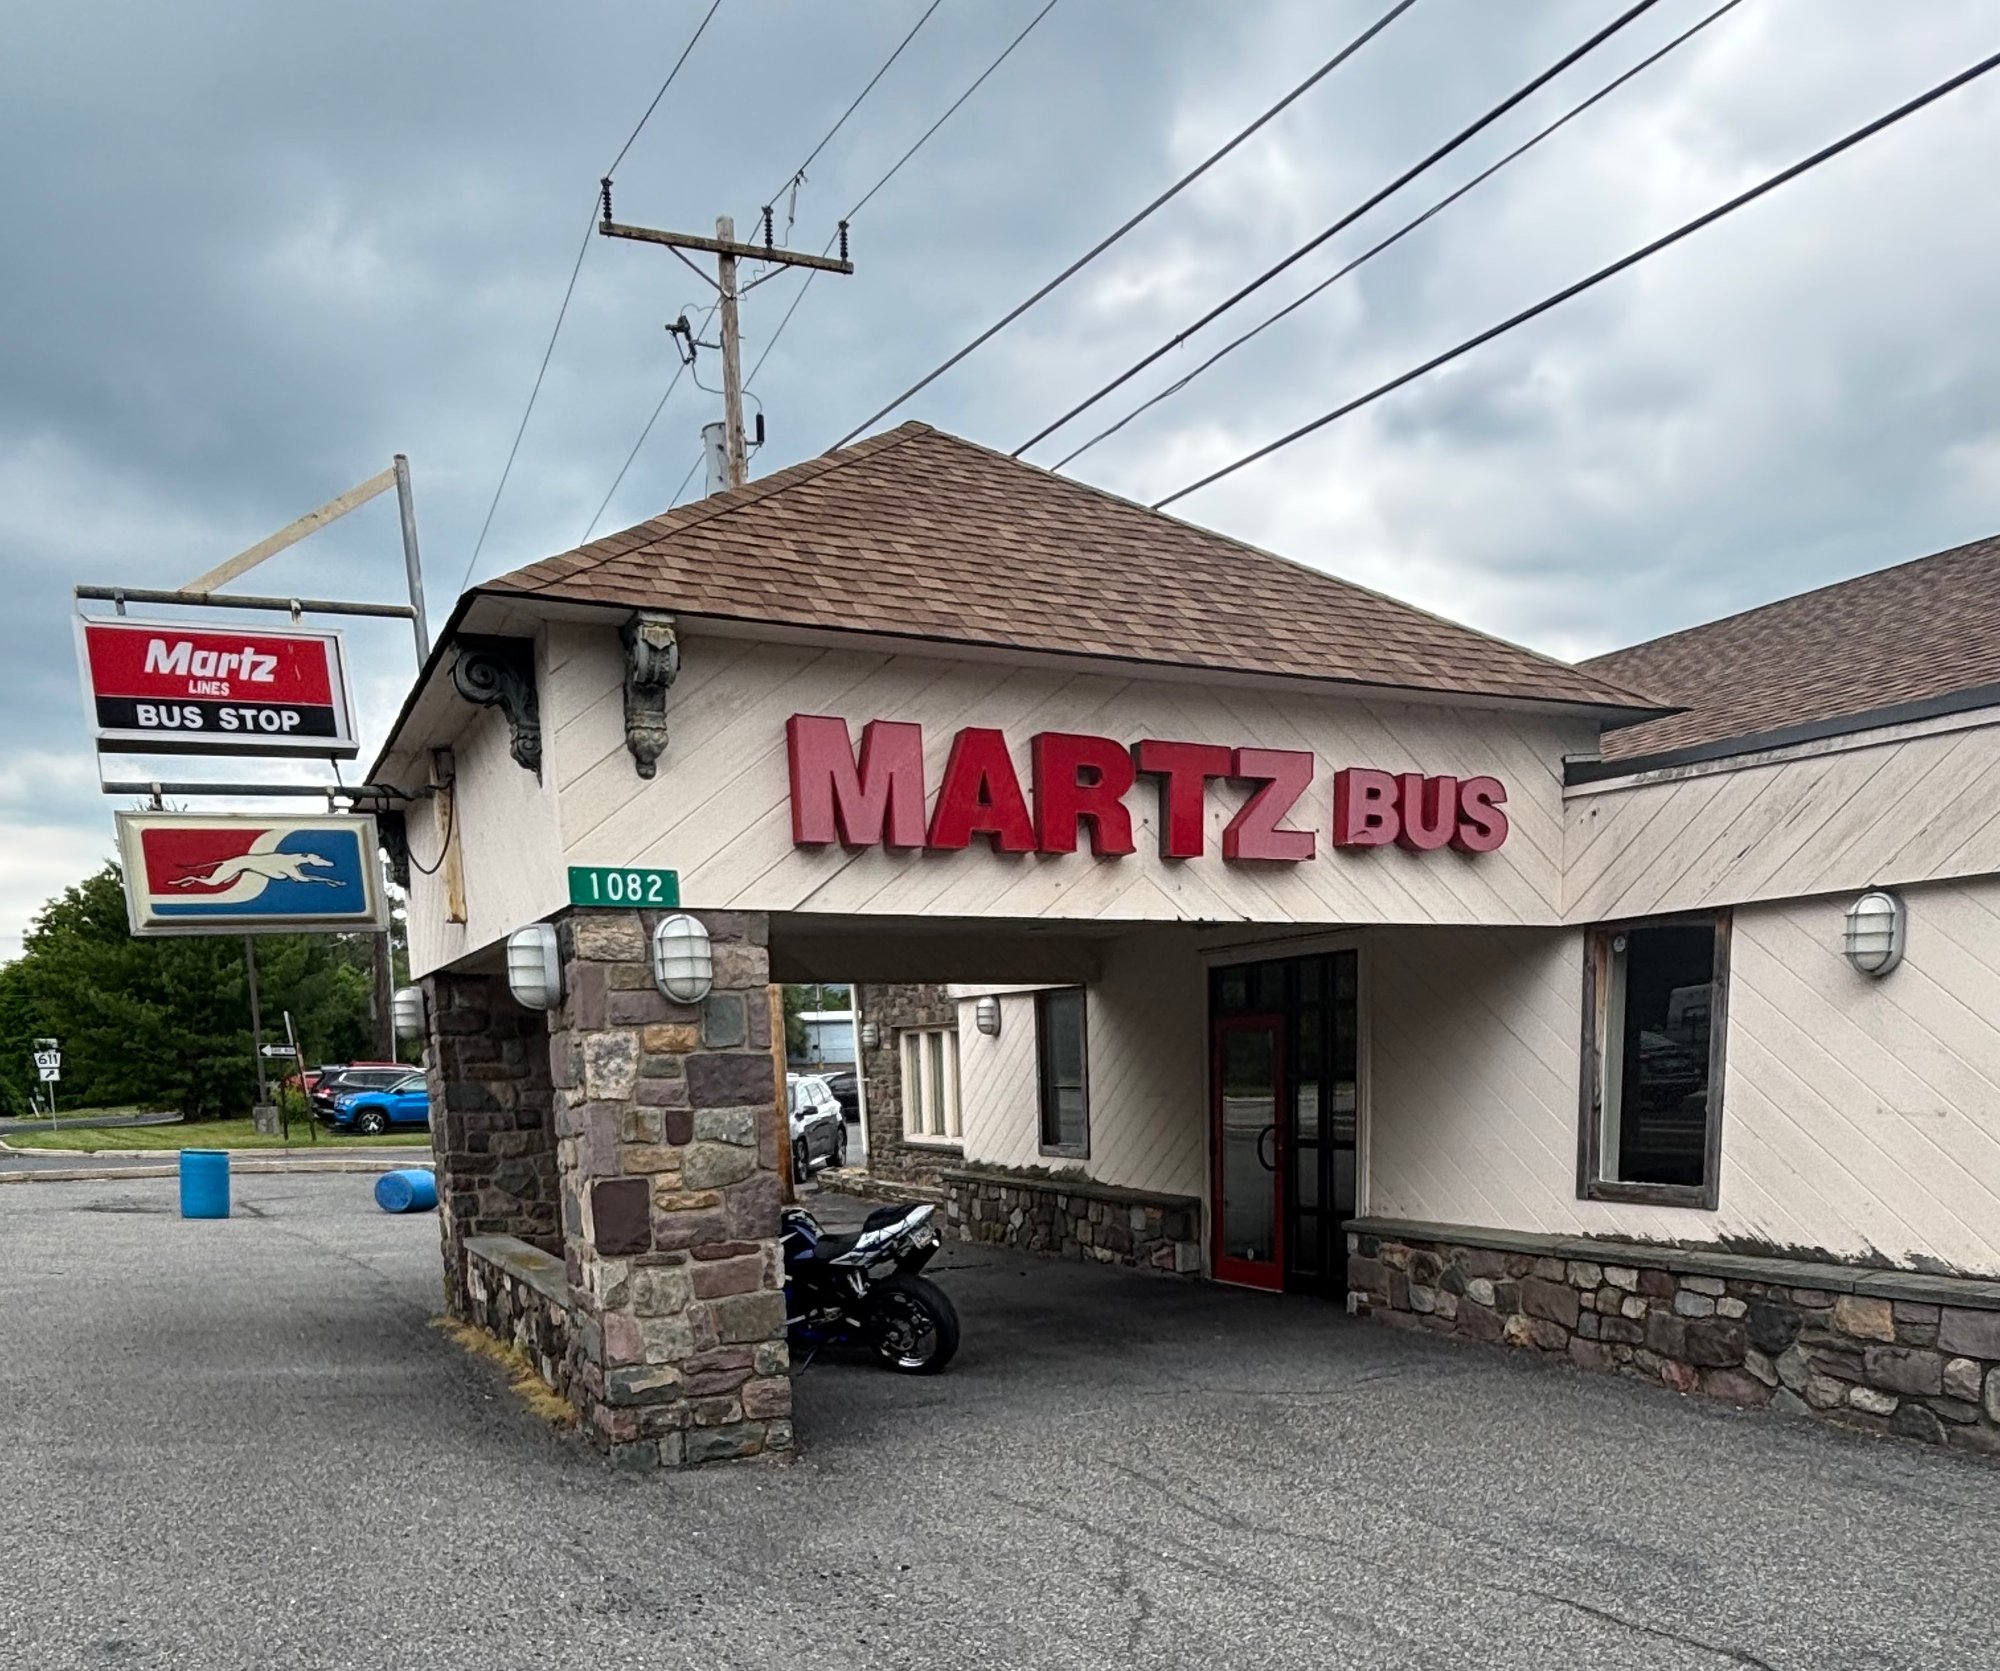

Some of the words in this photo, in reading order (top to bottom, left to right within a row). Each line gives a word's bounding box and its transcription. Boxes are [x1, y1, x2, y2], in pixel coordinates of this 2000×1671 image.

[144, 638, 278, 683] Martz
[188, 679, 231, 697] LINES
[136, 704, 204, 729] BUS
[218, 707, 301, 732] STOP
[786, 713, 1316, 862] MARTZ
[1333, 767, 1509, 853] BUS
[589, 872, 664, 902] 1082
[38, 1054, 58, 1065] 611
